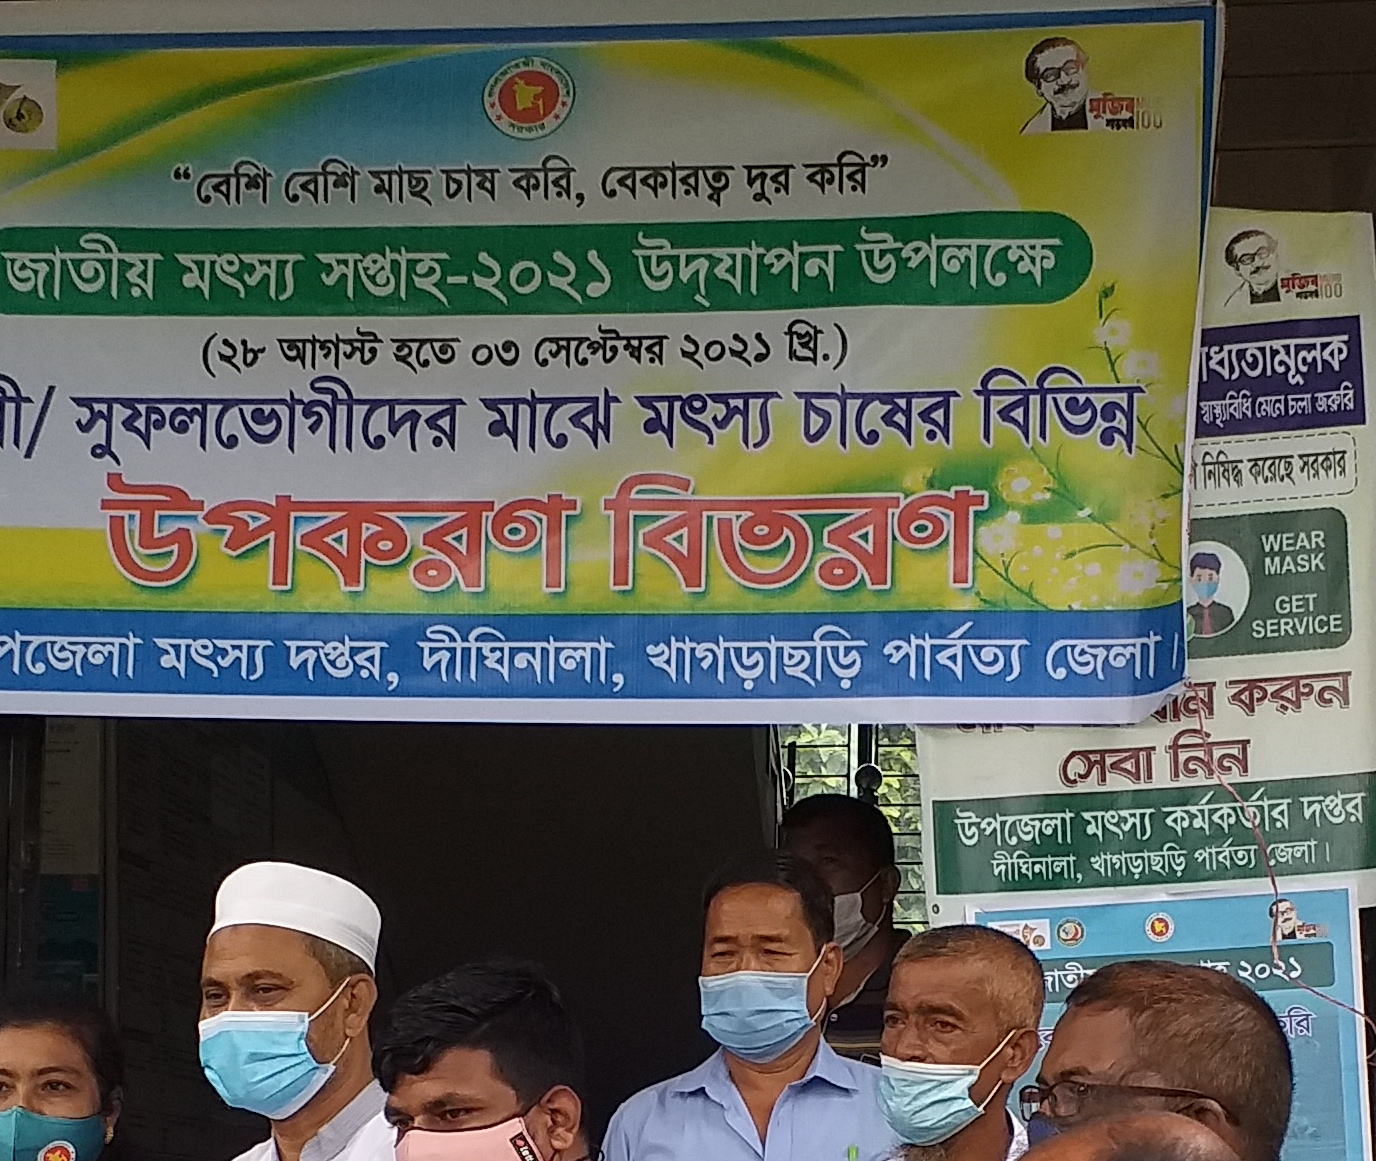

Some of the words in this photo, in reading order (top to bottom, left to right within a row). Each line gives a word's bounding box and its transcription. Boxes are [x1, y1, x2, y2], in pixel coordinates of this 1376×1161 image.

[285, 158, 361, 204] বেশি
[369, 164, 432, 206] মাছ
[440, 163, 500, 203] চাষ
[508, 154, 585, 208] করি,
[601, 161, 735, 207] বেকারত্ব
[1, 232, 162, 301] জাতীয়
[175, 251, 305, 301] মৎস্য
[320, 245, 612, 307] সপ্তাহ-২০২১
[855, 226, 1063, 290] উপলক্ষে
[277, 327, 383, 371] আগস্ট
[390, 337, 461, 374] হতে
[472, 340, 520, 367] ০৩
[533, 325, 668, 368] সেপ্টেম্বর
[680, 332, 771, 370] ২০২১
[1200, 335, 1349, 386] াধ্যতামূলক
[69, 376, 466, 466] সুফলভোগীদের
[480, 386, 621, 453] মাঝে
[638, 391, 780, 452] মৎস্য
[798, 384, 961, 450] চাষের
[974, 364, 1145, 456] বিভিন্ন
[1255, 395, 1284, 419] মেনে
[1287, 393, 1312, 416] চলা
[1315, 381, 1355, 414] জরুরি
[1201, 450, 1244, 491] নিষিদ্ধ
[1247, 455, 1296, 486] করেছে
[1298, 448, 1348, 482] সরকার
[100, 471, 581, 592] উপকরণ
[602, 471, 989, 592] বিতরণ
[1261, 530, 1325, 553] WEAR
[1264, 553, 1326, 576] MASK
[1251, 615, 1343, 639] SERVICE
[1275, 594, 1317, 615] GET
[153, 635, 274, 682] মৎস্য
[287, 633, 399, 692] দপ্তর,
[417, 625, 625, 693] দীঘিনালা,
[646, 625, 866, 690] খাগড়াছড়ি
[884, 621, 1030, 685] পার্বত্য
[1226, 671, 1352, 716] করুন
[1059, 746, 1156, 788] সেবা
[1165, 729, 1251, 783] নিন
[954, 807, 1075, 847] উপজেলা
[1081, 808, 1156, 844] মৎস্য
[1164, 788, 1292, 838] কর্মকর্তার
[1300, 791, 1366, 827] দপ্তর
[1090, 843, 1188, 880] খাগড়াছড়ি
[1194, 837, 1258, 872] পার্বত্য
